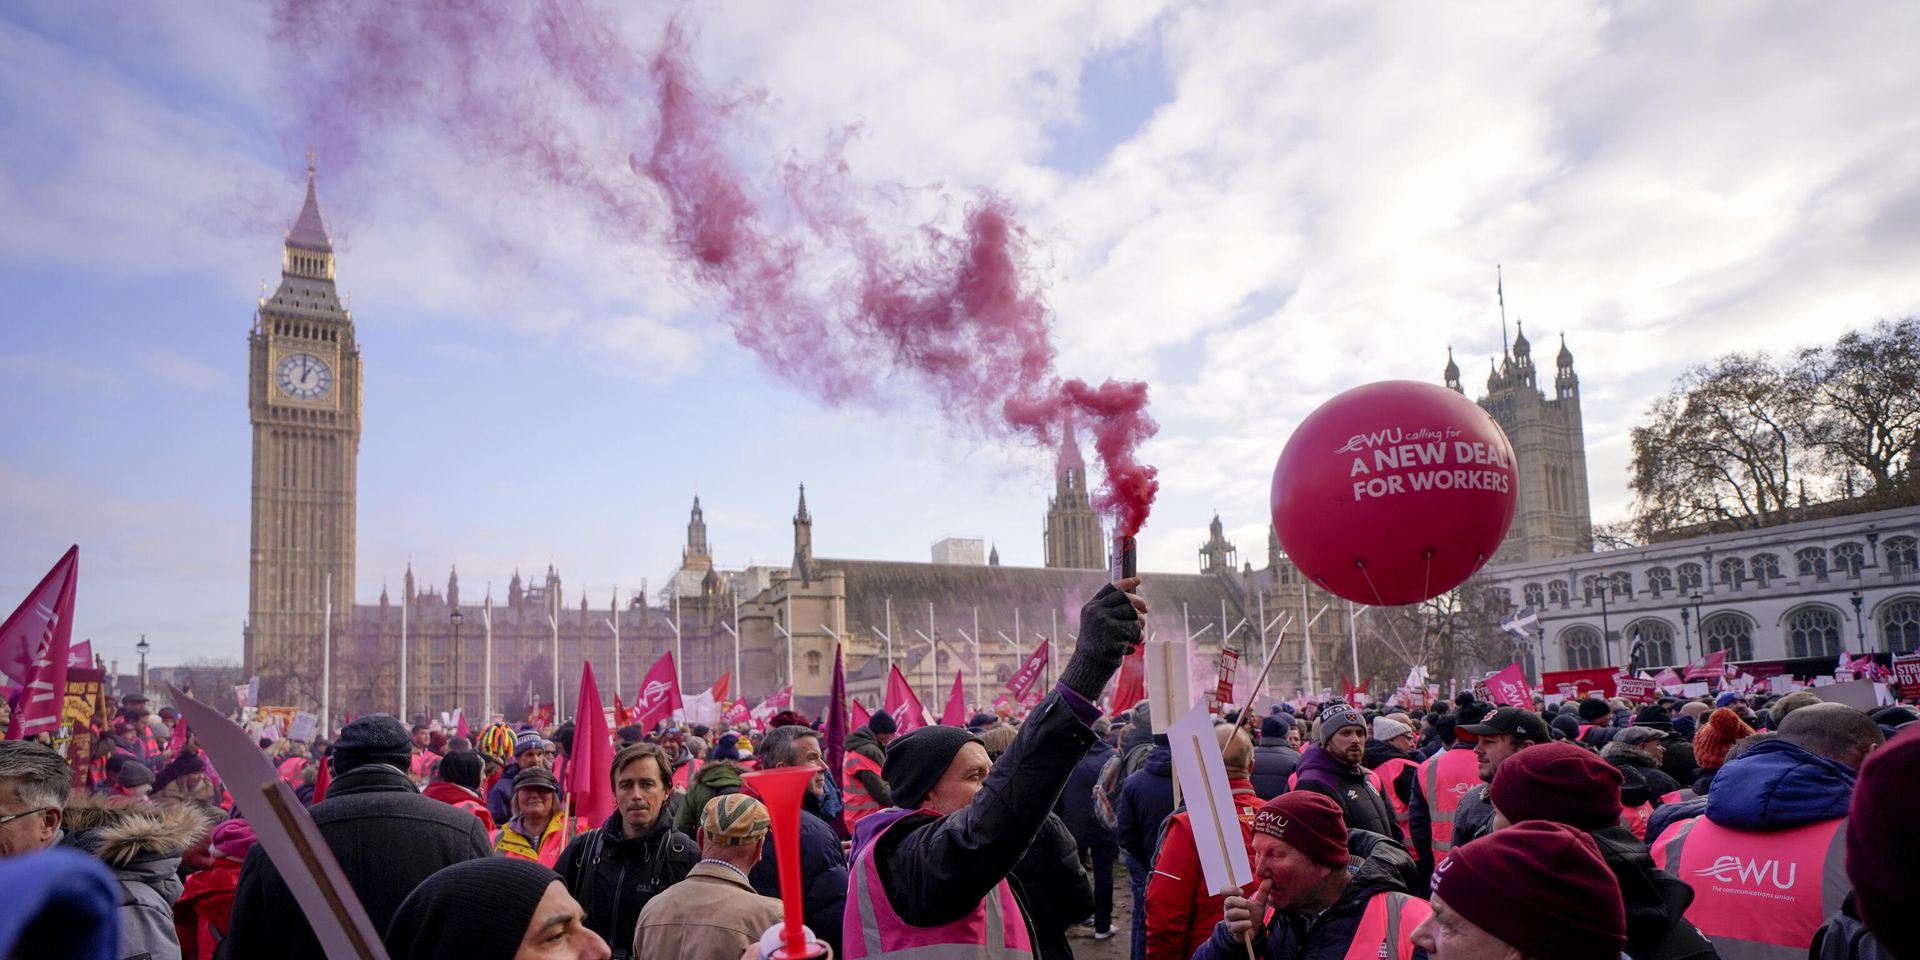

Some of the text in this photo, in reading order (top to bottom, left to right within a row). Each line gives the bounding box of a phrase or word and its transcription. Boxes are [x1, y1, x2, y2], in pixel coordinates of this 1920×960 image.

[1405, 428, 1442, 444] calling
[1445, 426, 1462, 443] for
[1350, 441, 1509, 478] A NEW DEAL
[1353, 470, 1509, 501] FOR WORKERS
[1898, 674, 1913, 685] TO
[1621, 685, 1643, 695] OUT!
[1712, 885, 1795, 902] The communications union
